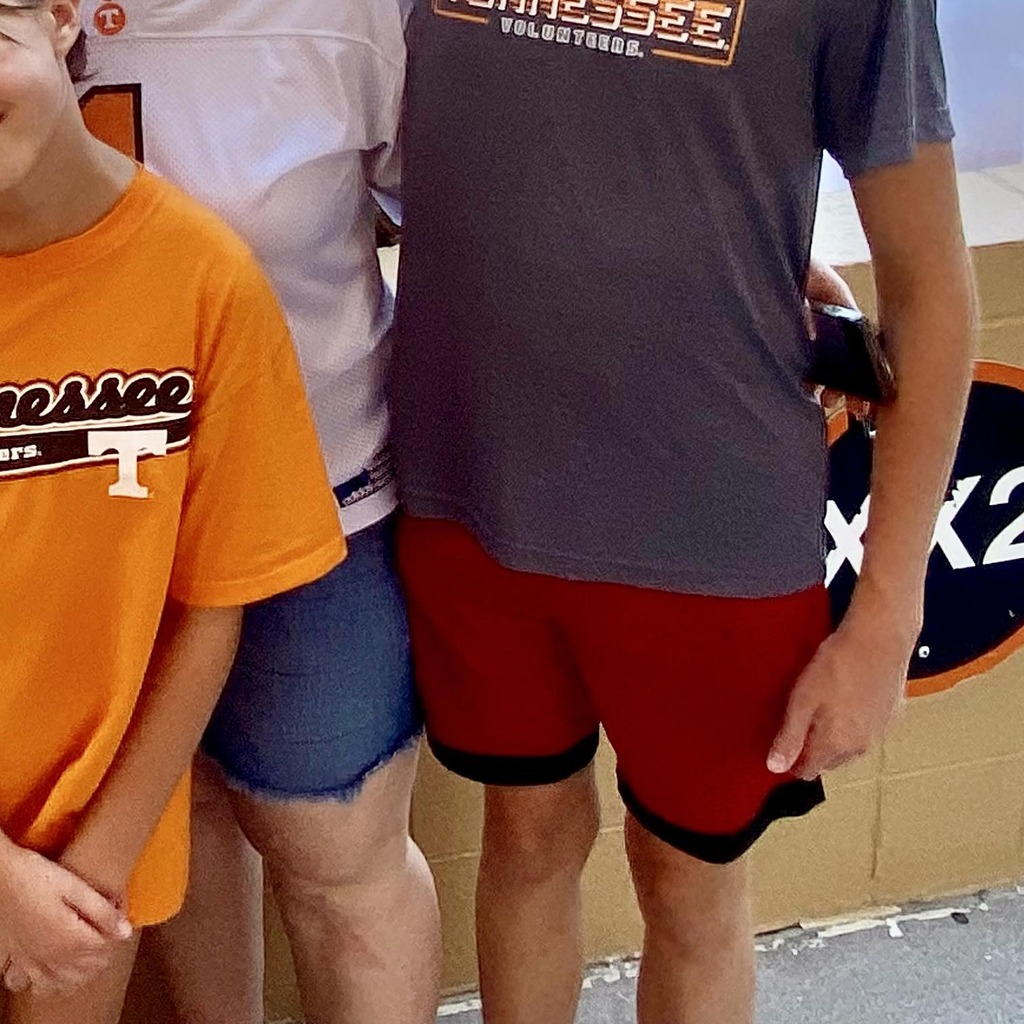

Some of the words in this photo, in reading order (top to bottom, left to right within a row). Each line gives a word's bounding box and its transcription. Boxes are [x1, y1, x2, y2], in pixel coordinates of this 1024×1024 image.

[99, 8, 120, 29] T
[500, 16, 641, 58] VOLUNTEERS
[87, 429, 168, 499] T
